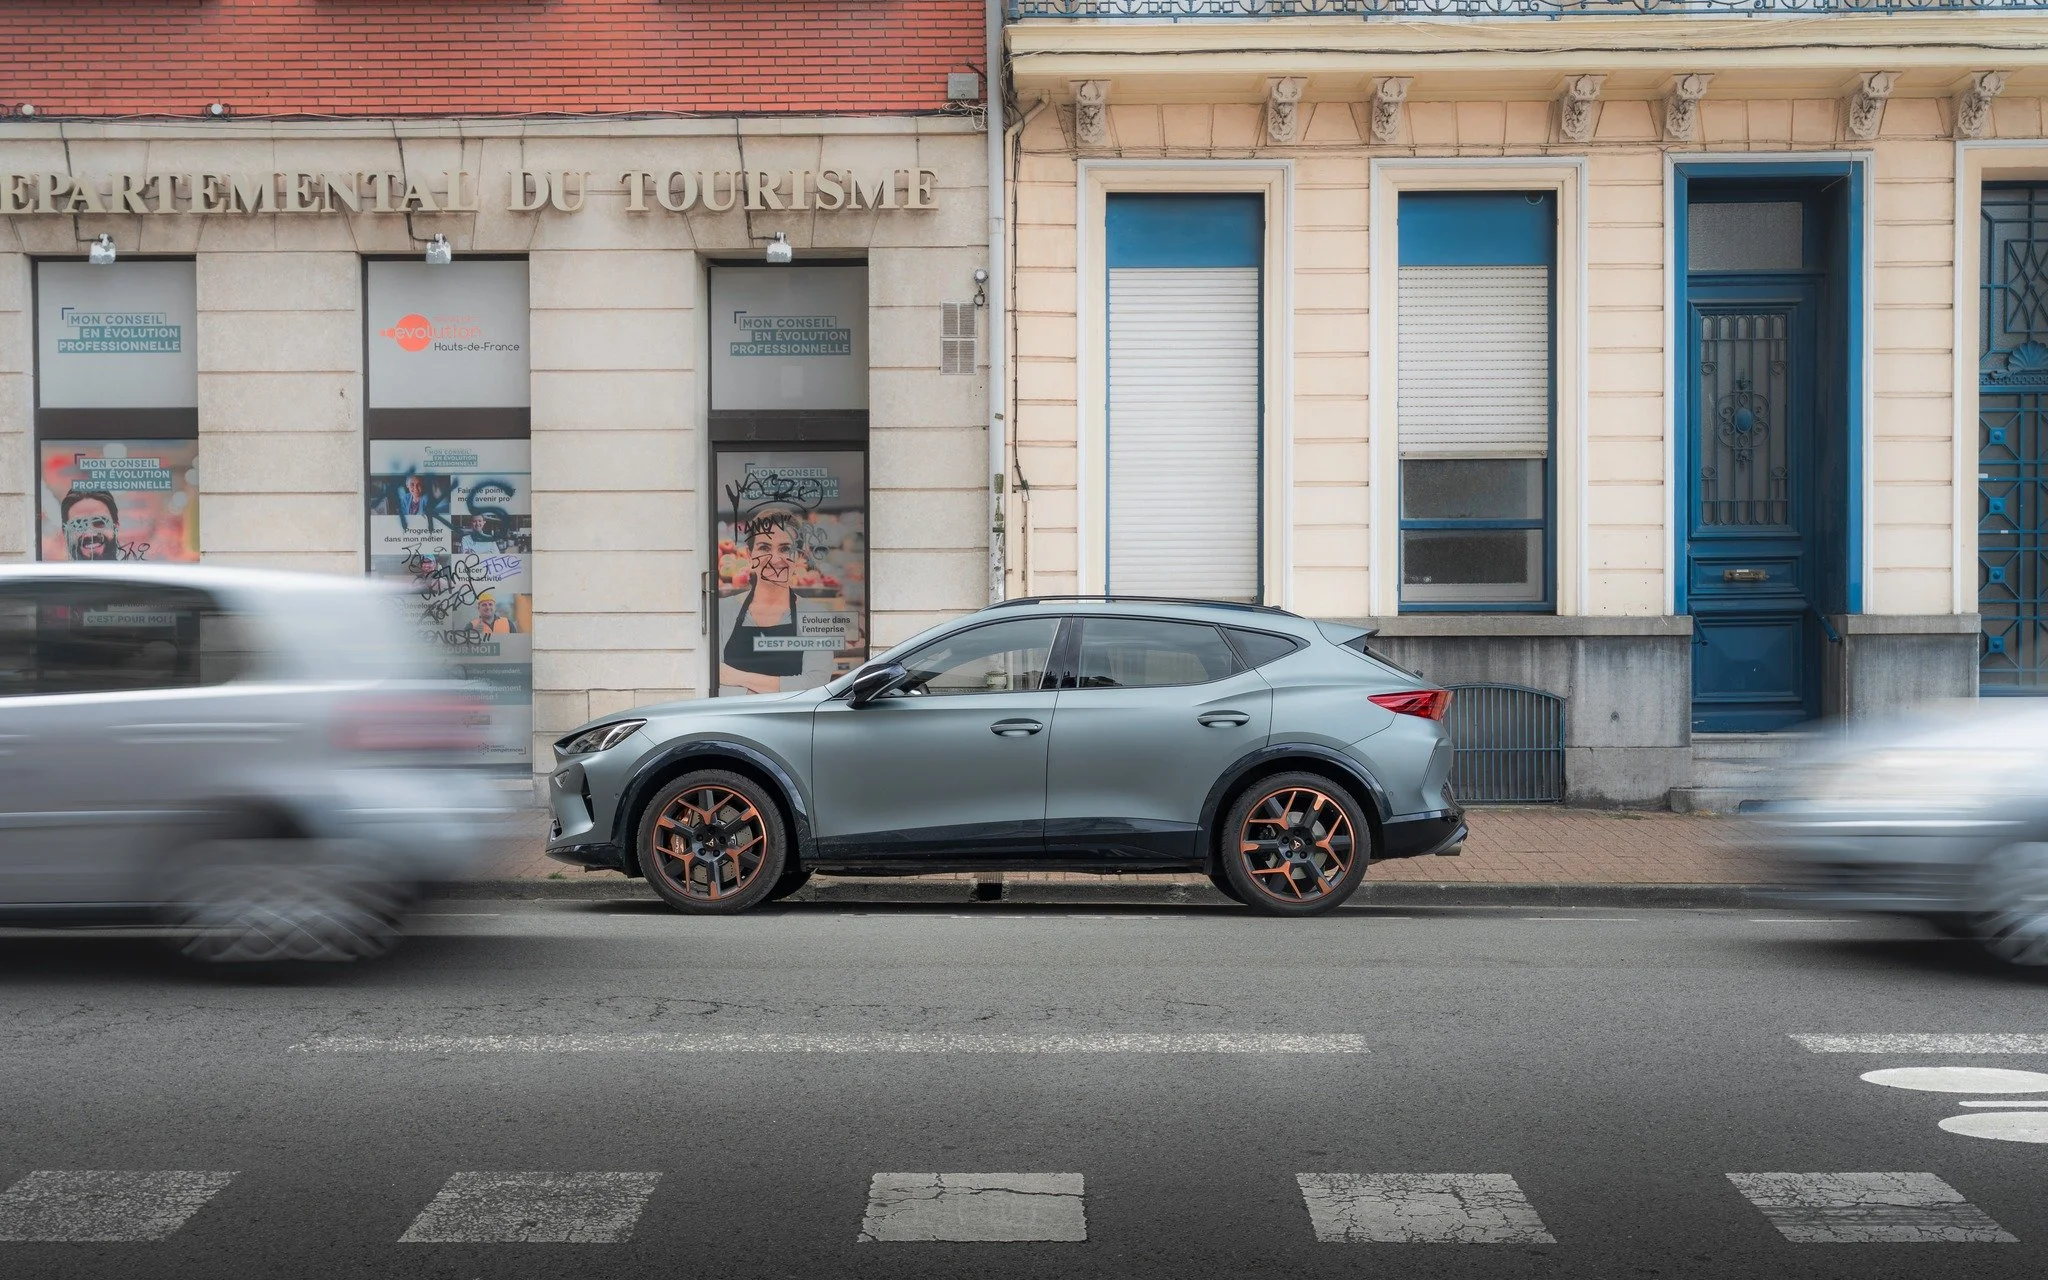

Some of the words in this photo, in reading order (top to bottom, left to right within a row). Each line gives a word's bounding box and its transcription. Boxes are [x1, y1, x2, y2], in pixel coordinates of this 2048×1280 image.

[0, 170, 479, 214] EPARTEMENTAL
[506, 170, 588, 212] DU
[618, 167, 938, 212] TOURISME
[71, 315, 100, 325] MON
[105, 315, 163, 325] CONSEIL
[743, 319, 772, 328] MON
[777, 319, 834, 328] CONSEIL
[82, 328, 100, 338] EN
[104, 326, 178, 338] ÉVOLUTION
[755, 331, 772, 341] EN
[776, 328, 848, 341] ÉVOLUTION
[60, 341, 180, 351] PROFESSIONNELLE
[434, 341, 520, 352] Hauts-de-France
[731, 344, 849, 354] PROFESSIONNELLE
[82, 459, 107, 469] MON
[111, 459, 158, 468] CONSEIL
[92, 470, 106, 479] EN
[110, 468, 170, 479] ÉVOLUTION
[752, 469, 776, 477] MON
[780, 469, 826, 477] CONSEIL
[73, 481, 171, 490] PROFESSIONNELLE
[485, 487, 503, 496] point
[743, 489, 839, 498] PROFONNELE
[499, 496, 510, 504] pro
[117, 615, 145, 624] POUR
[802, 615, 831, 624] Évoluer
[832, 616, 851, 624] dans
[802, 626, 845, 635] l'entreprise
[757, 639, 785, 648] C'EST
[787, 640, 814, 648] POUR
[471, 645, 491, 654] MOI
